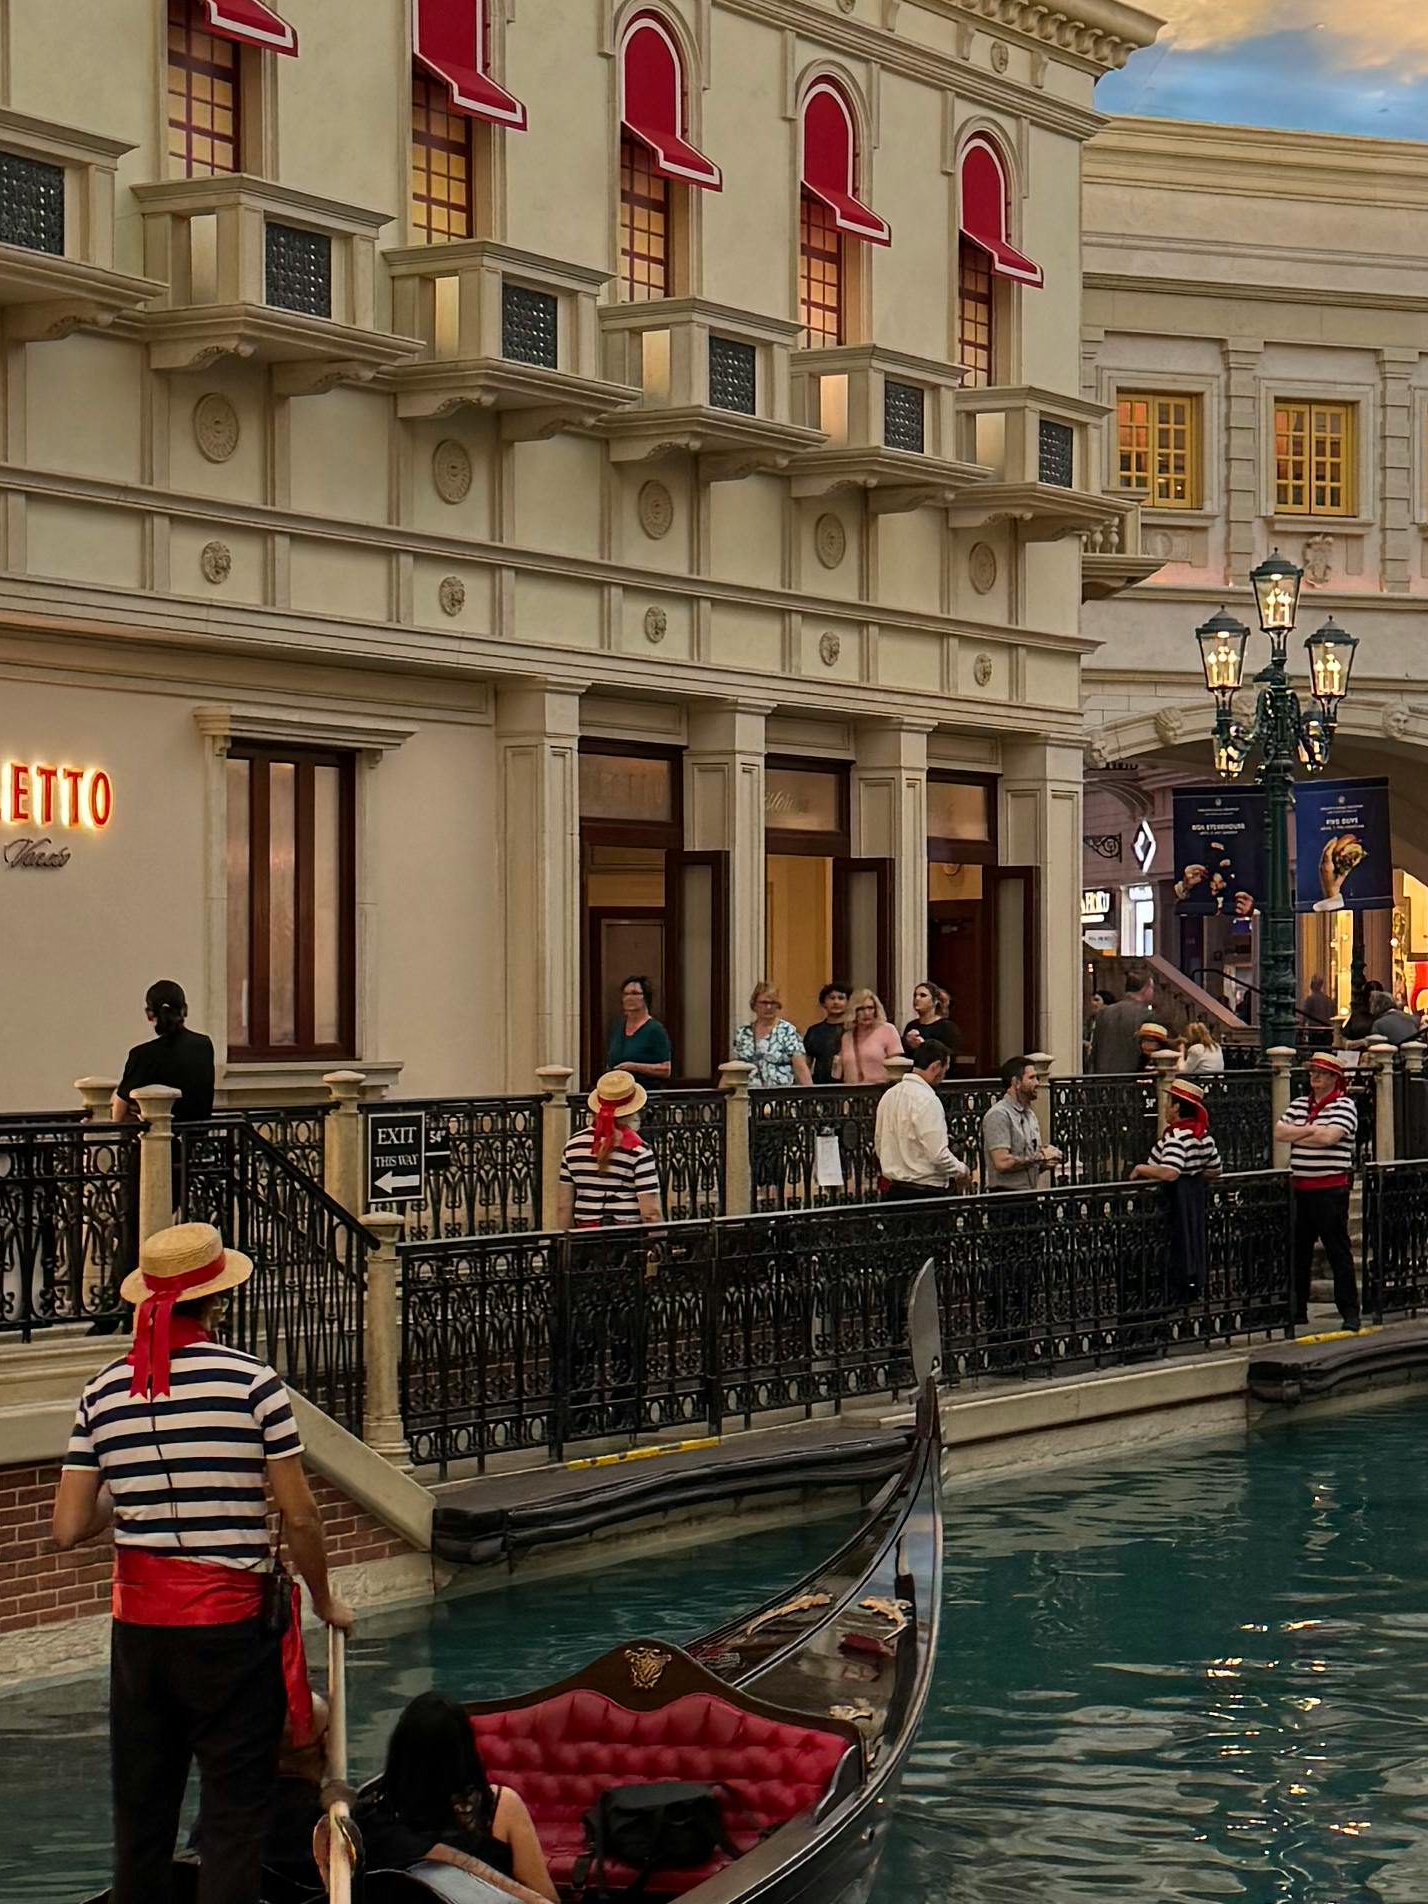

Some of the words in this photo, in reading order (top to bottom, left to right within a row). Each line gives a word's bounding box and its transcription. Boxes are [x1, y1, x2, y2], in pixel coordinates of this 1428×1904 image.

[377, 1126, 417, 1145] EXIT
[374, 1155, 397, 1168] THIS
[397, 1153, 420, 1166] WAY
